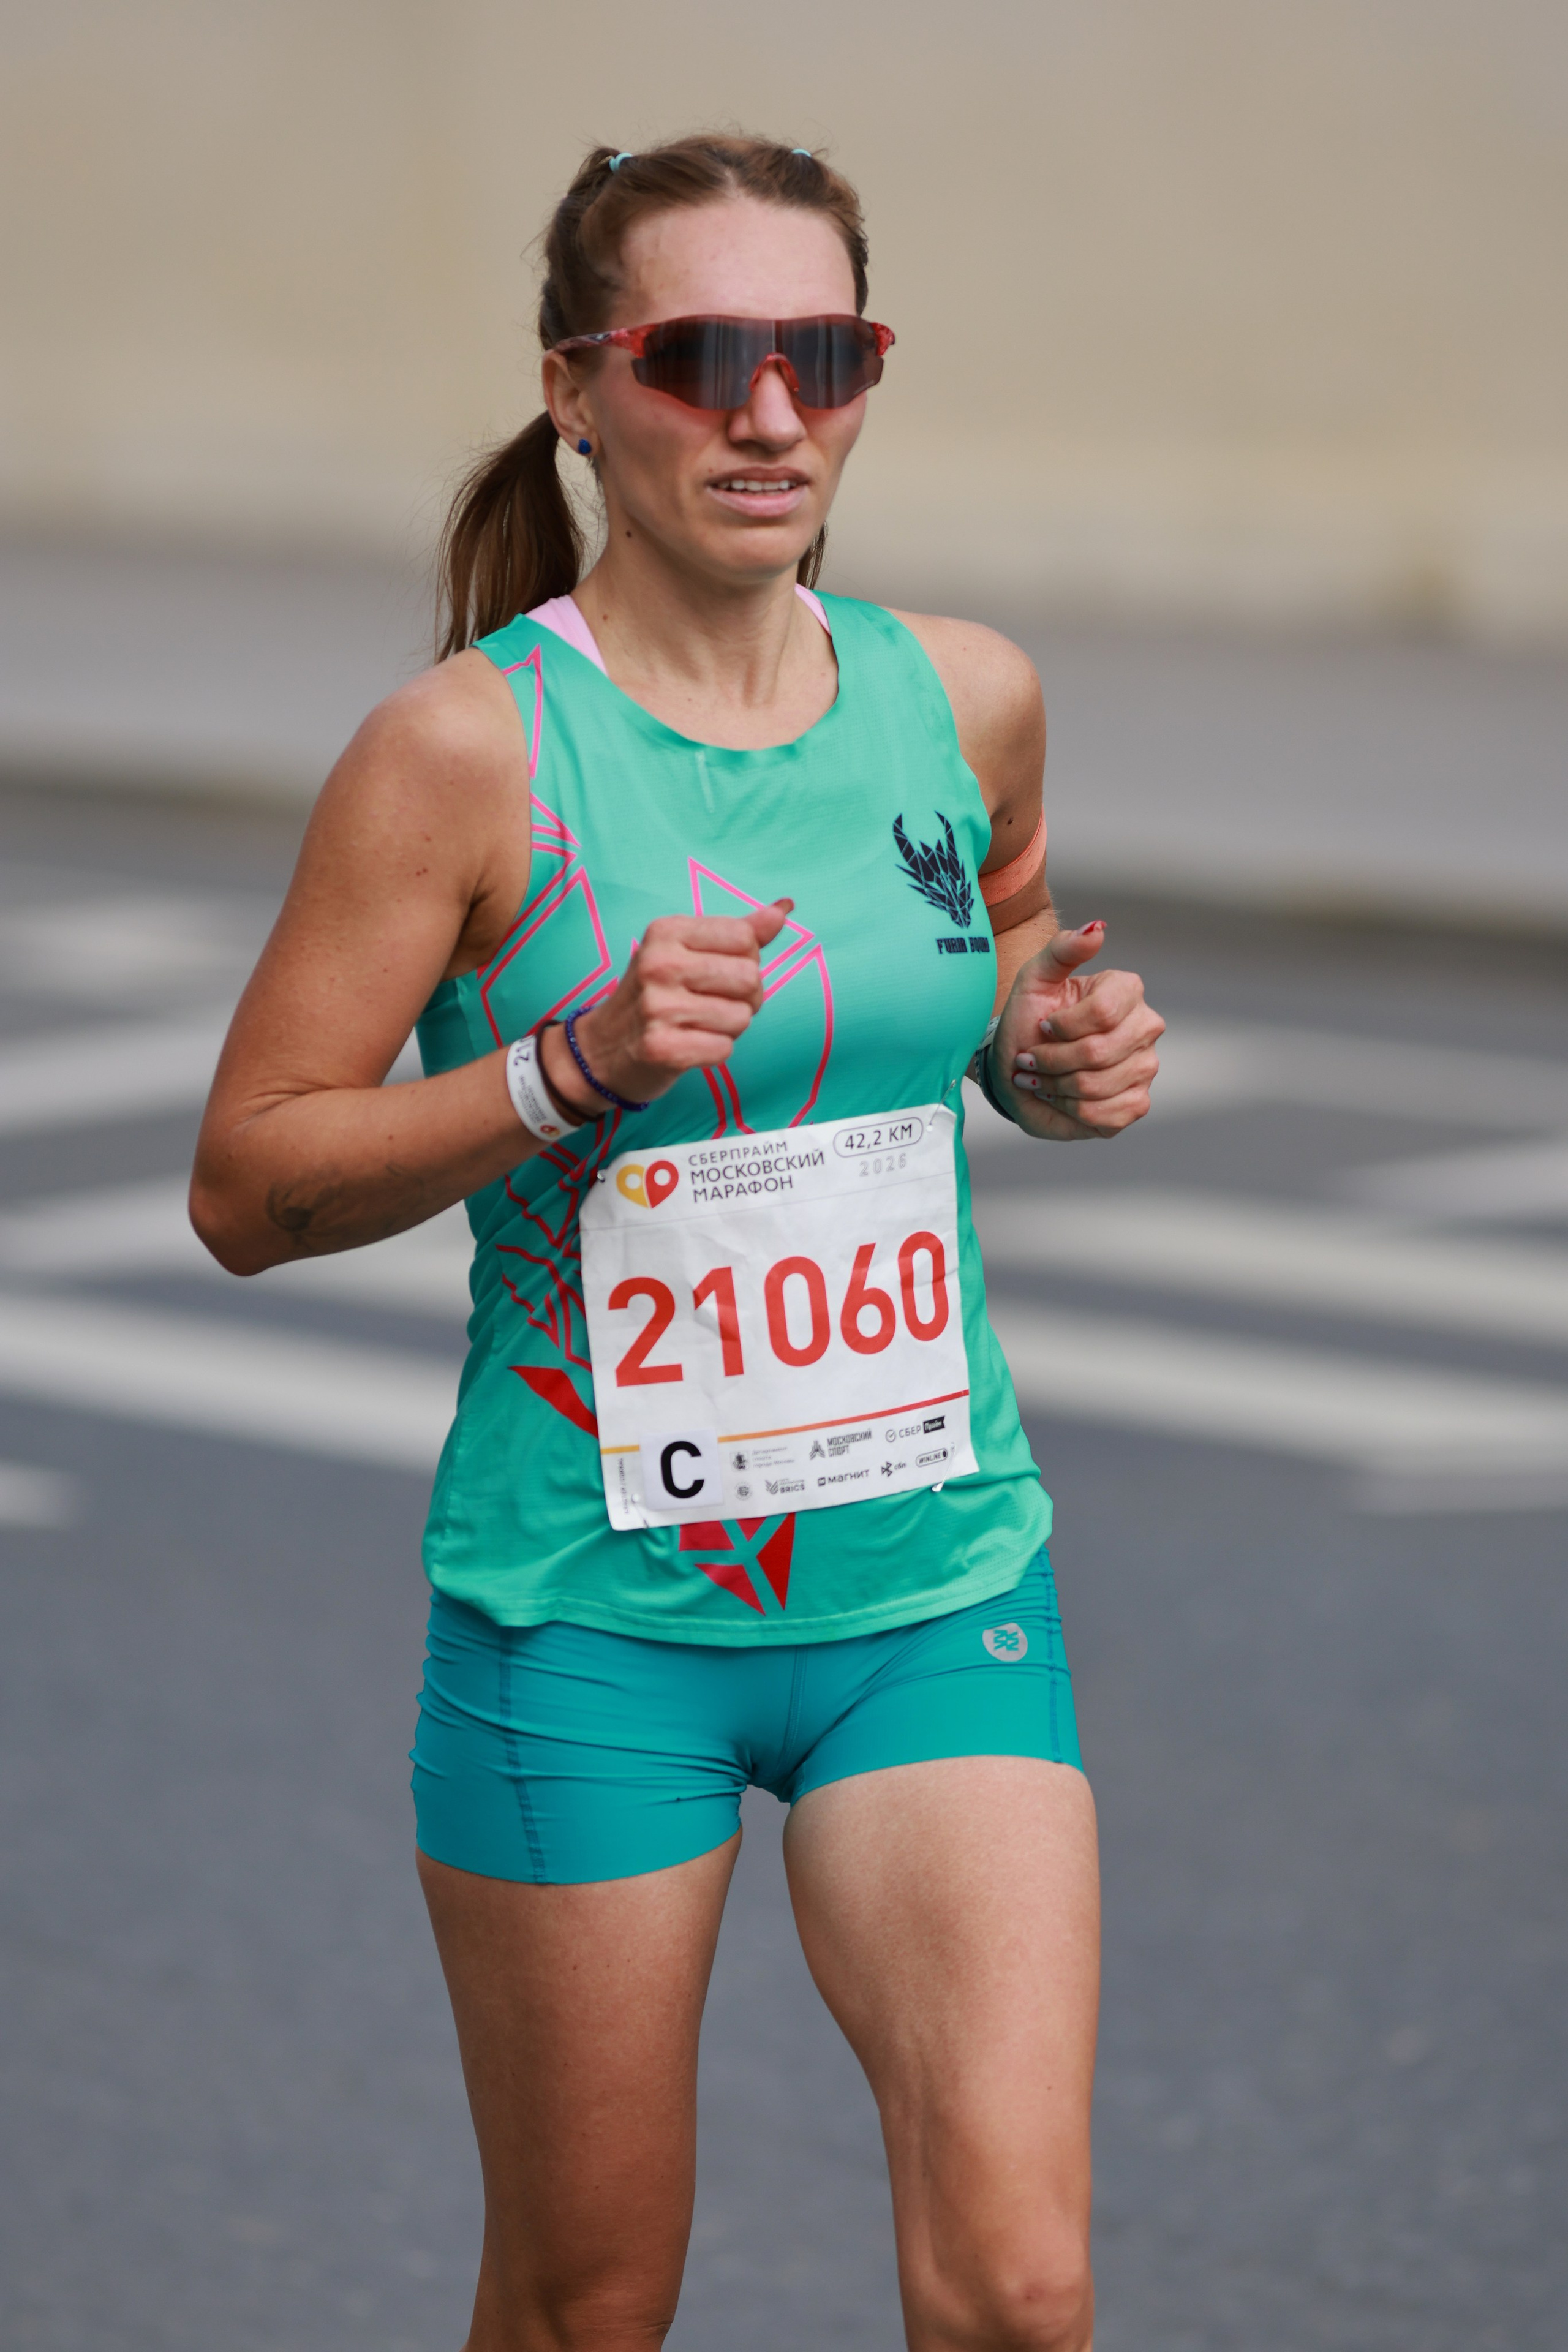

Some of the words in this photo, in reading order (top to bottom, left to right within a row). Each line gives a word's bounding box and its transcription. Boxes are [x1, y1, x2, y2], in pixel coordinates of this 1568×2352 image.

[845, 1129, 881, 1150] 42,2
[688, 1141, 788, 1166] СБЕРПРАЙМ
[690, 1148, 825, 1185] МОСКОВСКИЙ
[859, 1152, 907, 1177] 2026
[693, 1175, 793, 1204] МАРАФОН
[607, 1231, 949, 1387] 21060
[827, 1427, 872, 1446] МОСКОВСКИЙ
[898, 1425, 921, 1438] СБЕР
[827, 1445, 850, 1457] СПОРТ
[919, 1452, 941, 1464] WINLINE
[780, 1483, 805, 1494] BRICS
